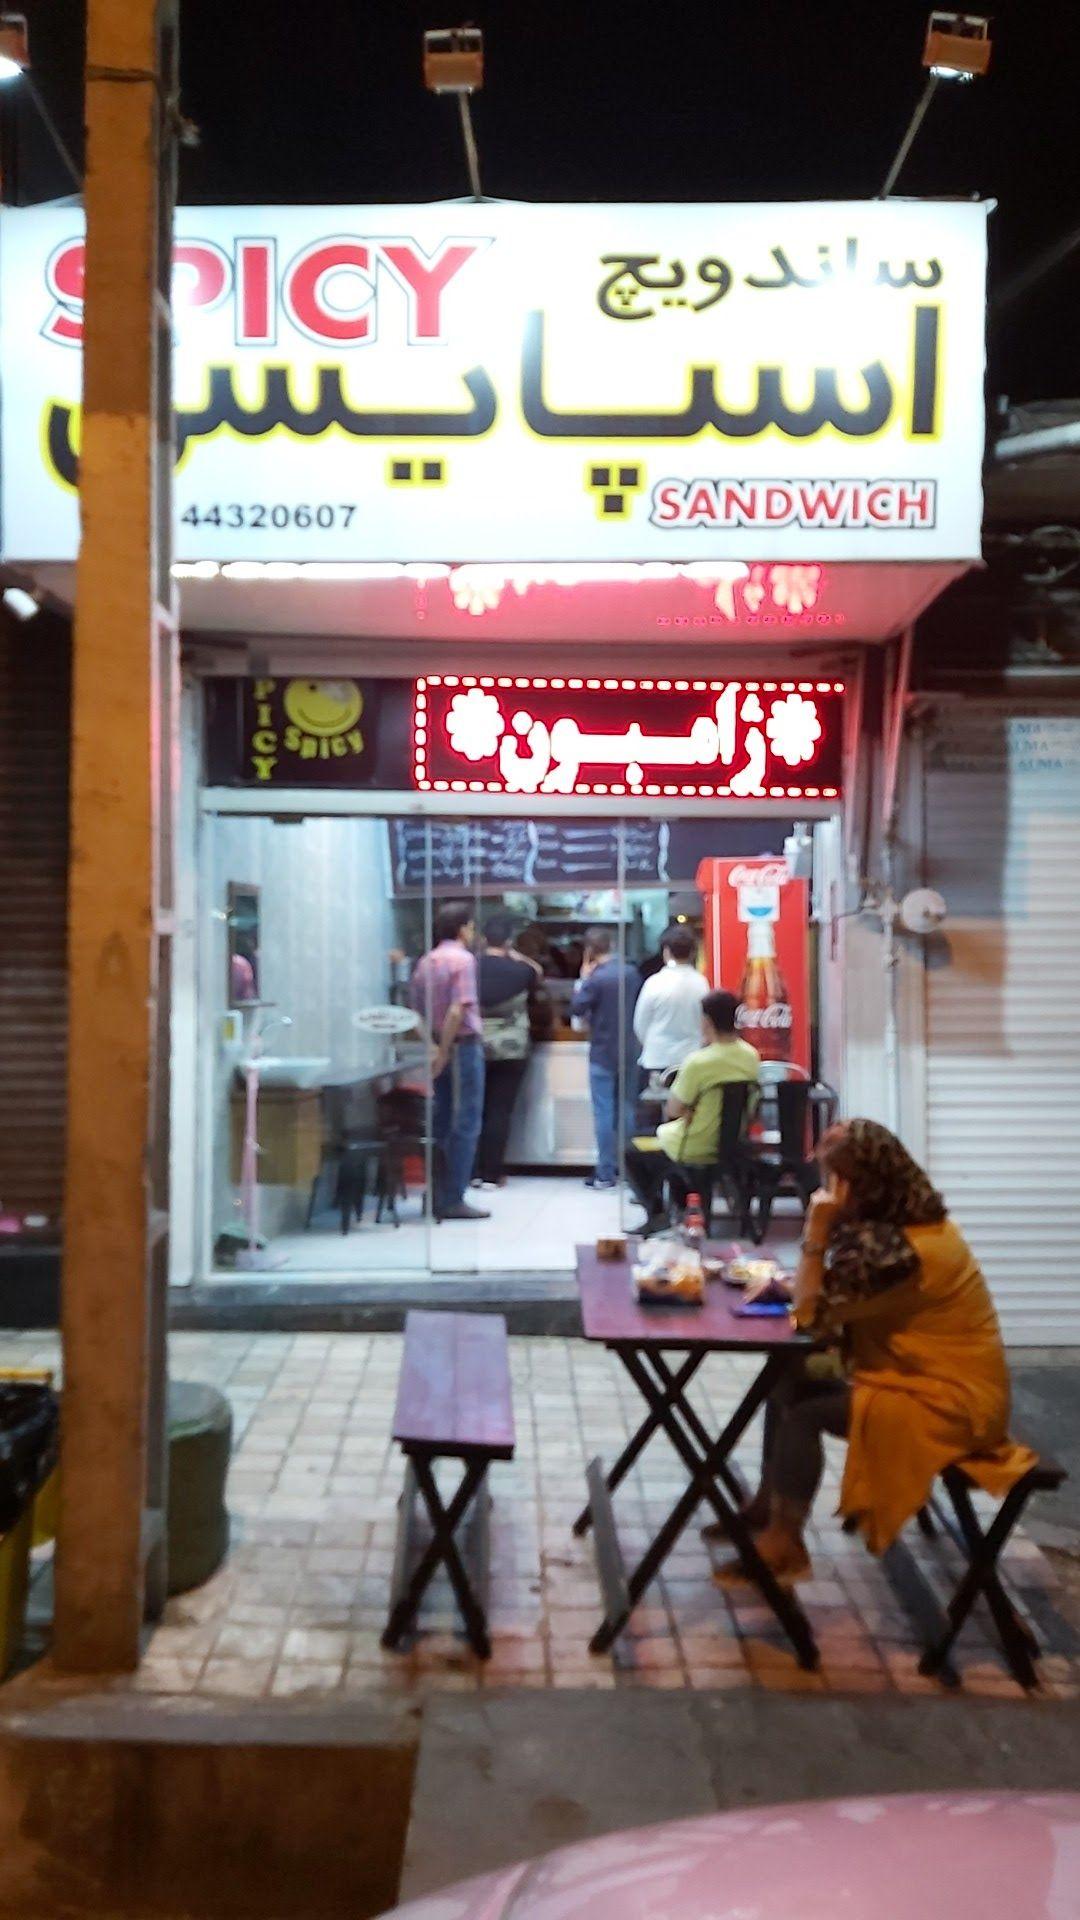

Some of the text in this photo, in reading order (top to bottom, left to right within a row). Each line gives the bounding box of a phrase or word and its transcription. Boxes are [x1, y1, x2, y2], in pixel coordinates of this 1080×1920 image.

[598, 238, 943, 320] ساندویچ
[181, 504, 357, 528] 44320607
[652, 480, 935, 526] SANDWICH
